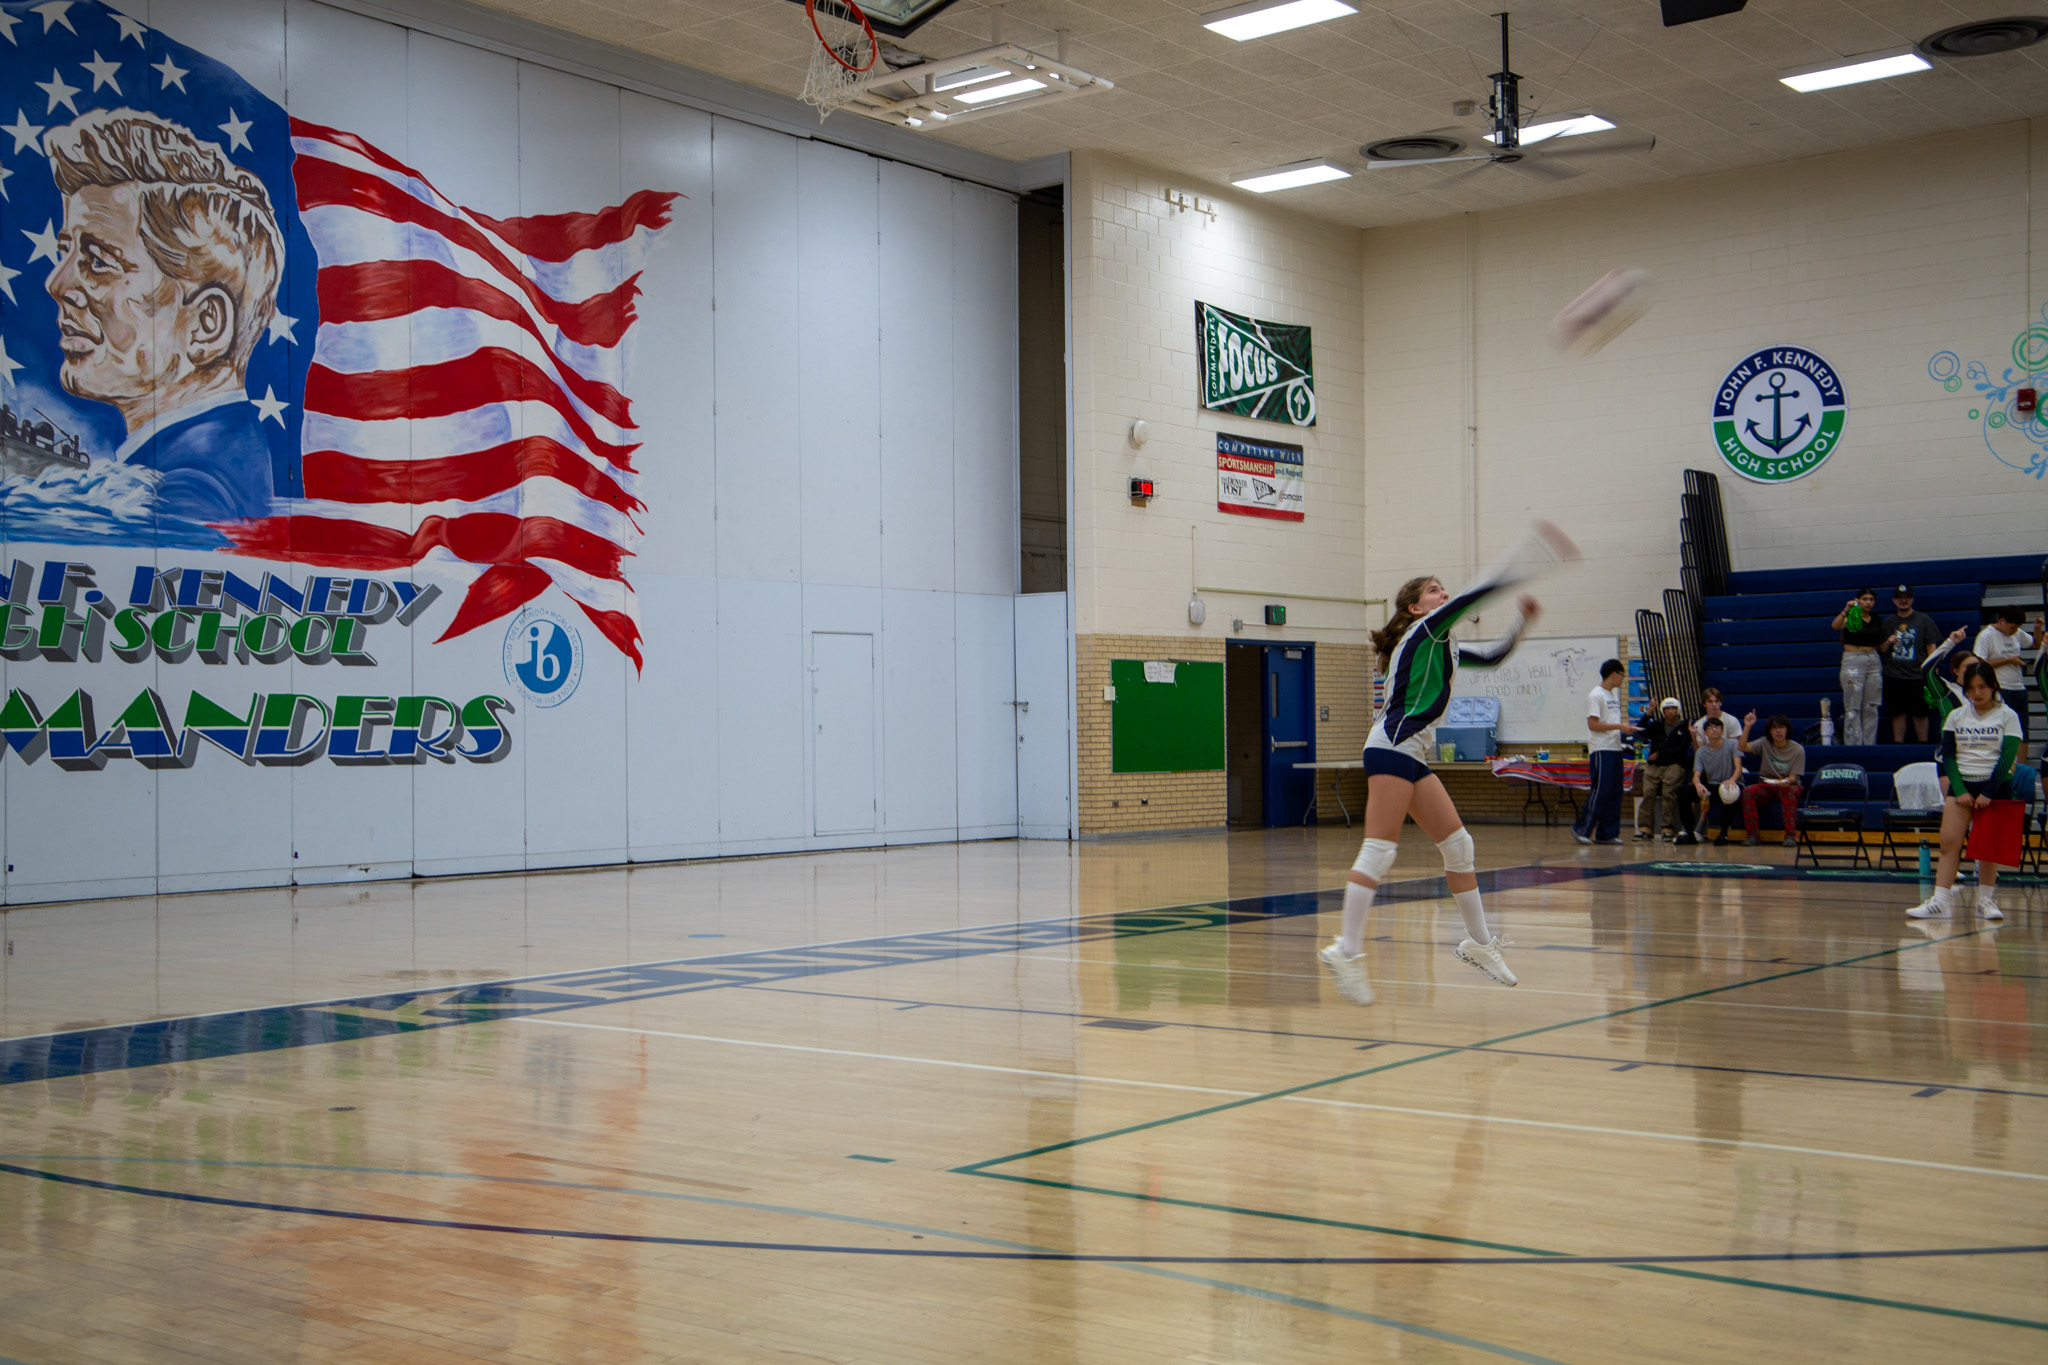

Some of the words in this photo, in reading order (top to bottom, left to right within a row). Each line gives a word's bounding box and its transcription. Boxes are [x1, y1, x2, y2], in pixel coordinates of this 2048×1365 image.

[1209, 317, 1218, 397] COMMANDERS
[1217, 322, 1278, 394] FOCUS
[1719, 366, 1752, 410] JOHN
[1754, 357, 1767, 370] F.
[1773, 351, 1839, 397] KENNEDY
[1218, 440, 1275, 458] COMPETING
[1723, 437, 1761, 472] HIGH
[1767, 430, 1835, 475] SCHOOL
[1218, 457, 1274, 475] SPORTSMANSHIP
[1223, 483, 1243, 496] POST
[129, 566, 442, 626] KENNEDY
[109, 606, 377, 666] SCHOOL
[550, 611, 572, 633] WORLD
[571, 635, 581, 669] SCHOOL
[1470, 669, 1490, 685] JFK
[1493, 667, 1519, 682] GIRLS
[1527, 664, 1553, 678] VBALL
[1486, 685, 1511, 697] FOOD
[1955, 726, 2000, 735] KENNEDY
[1820, 769, 1861, 779] KENNEDY
